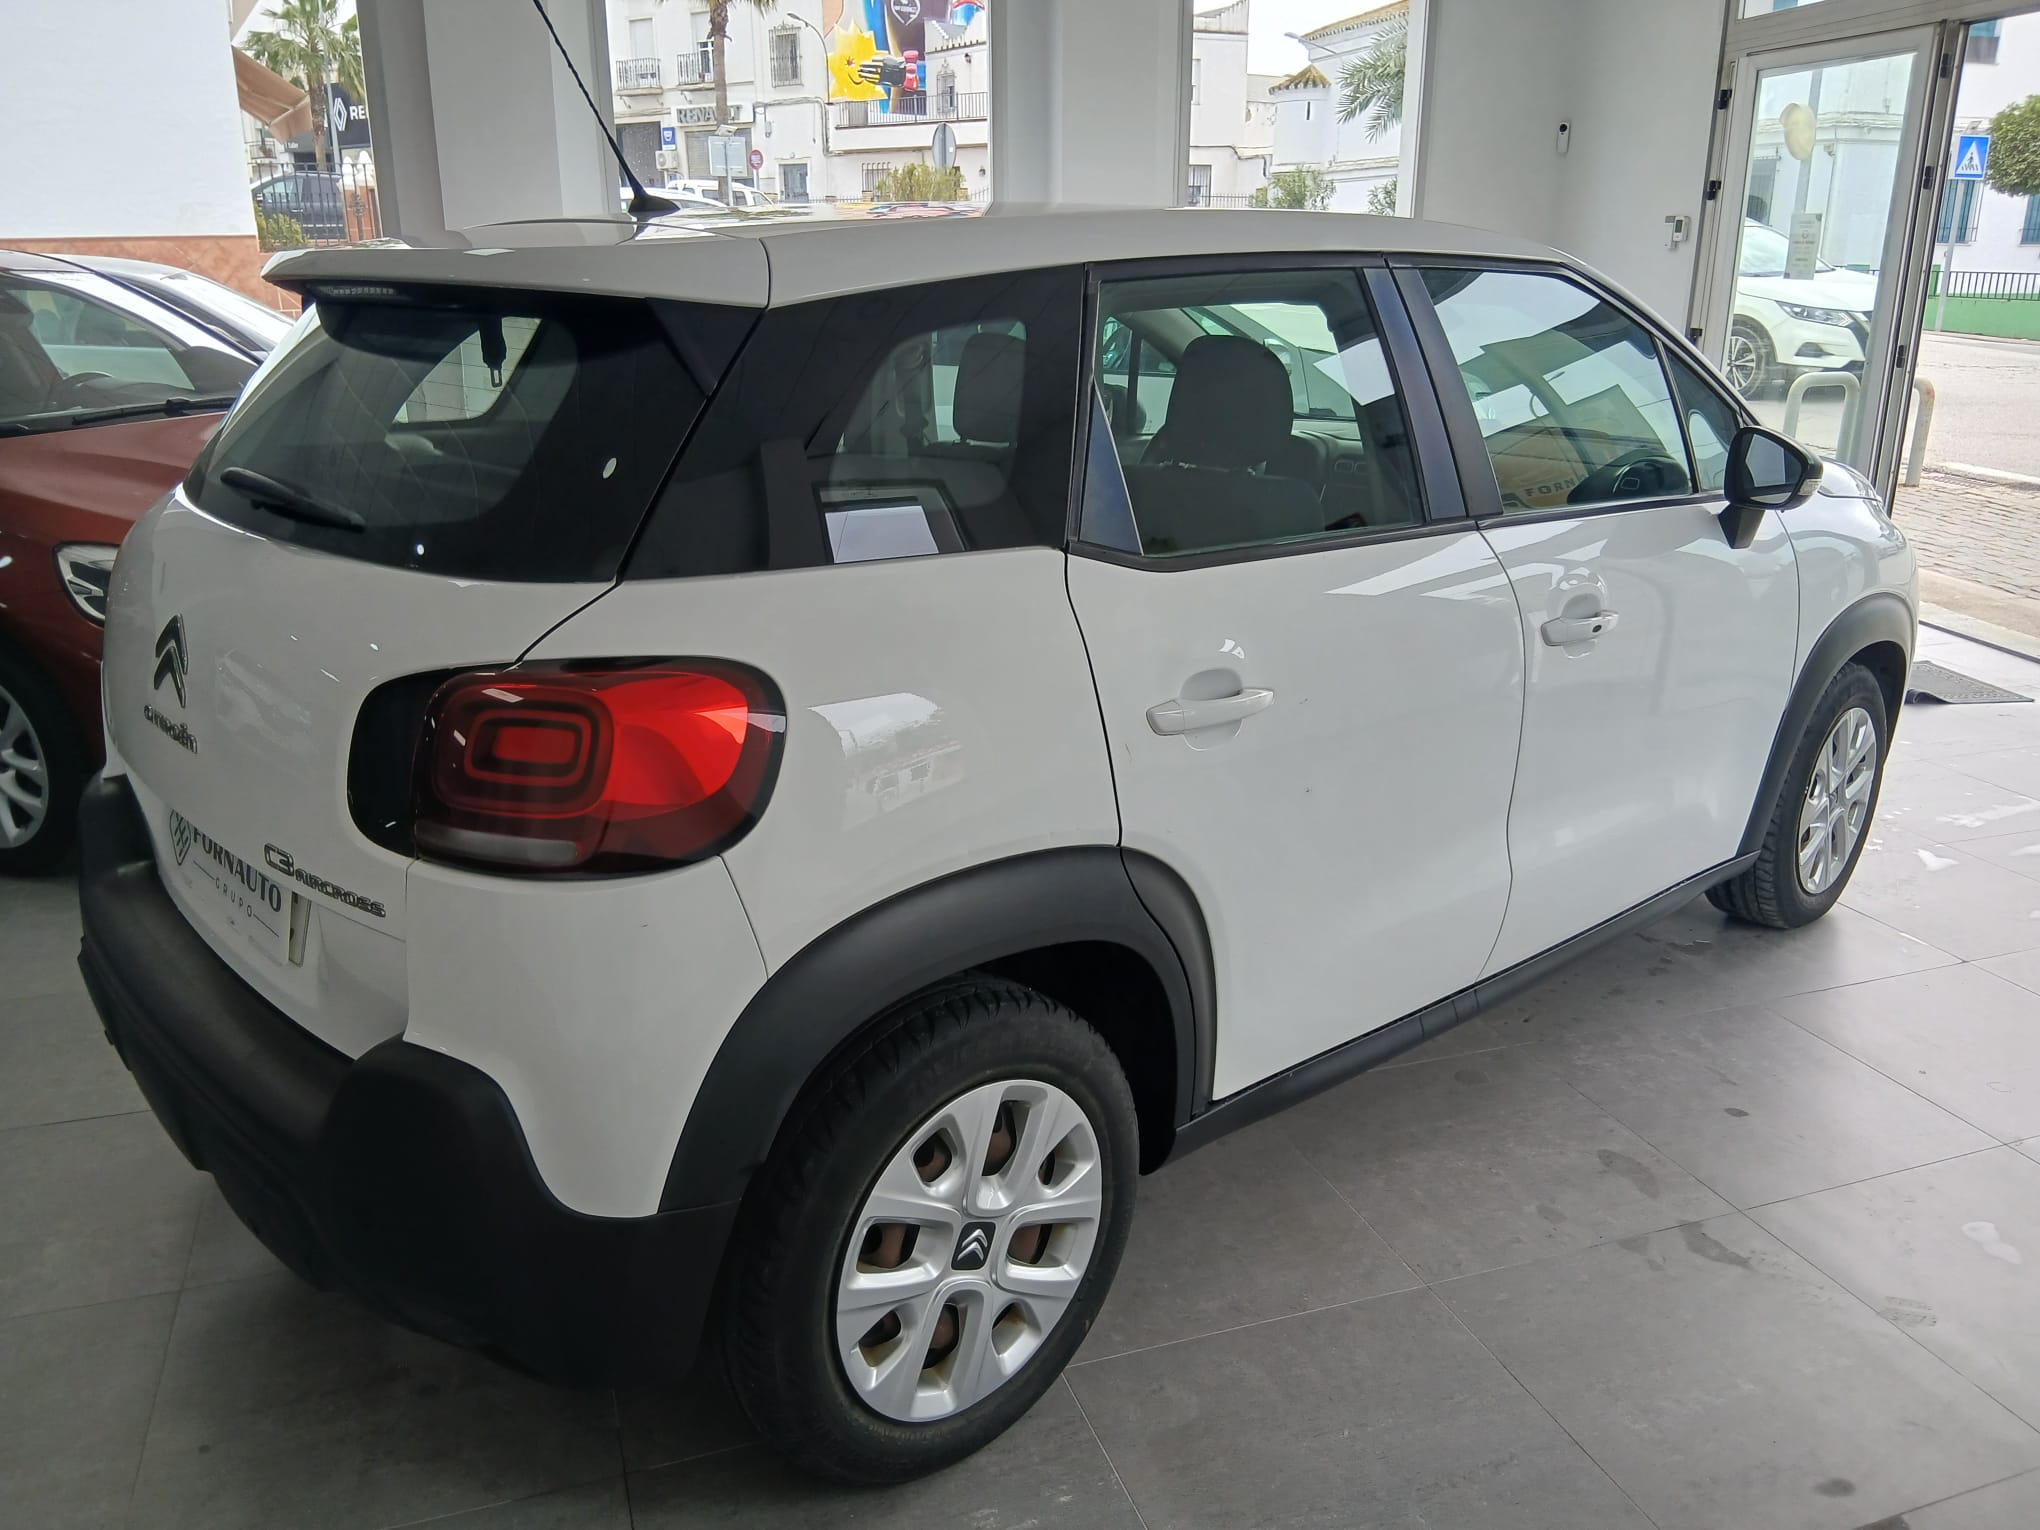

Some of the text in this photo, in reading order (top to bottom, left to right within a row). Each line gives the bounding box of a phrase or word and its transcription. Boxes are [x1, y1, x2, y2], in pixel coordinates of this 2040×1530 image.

[349, 105, 367, 120] RE
[676, 104, 743, 123] RENALT
[1524, 477, 1580, 498] FORN
